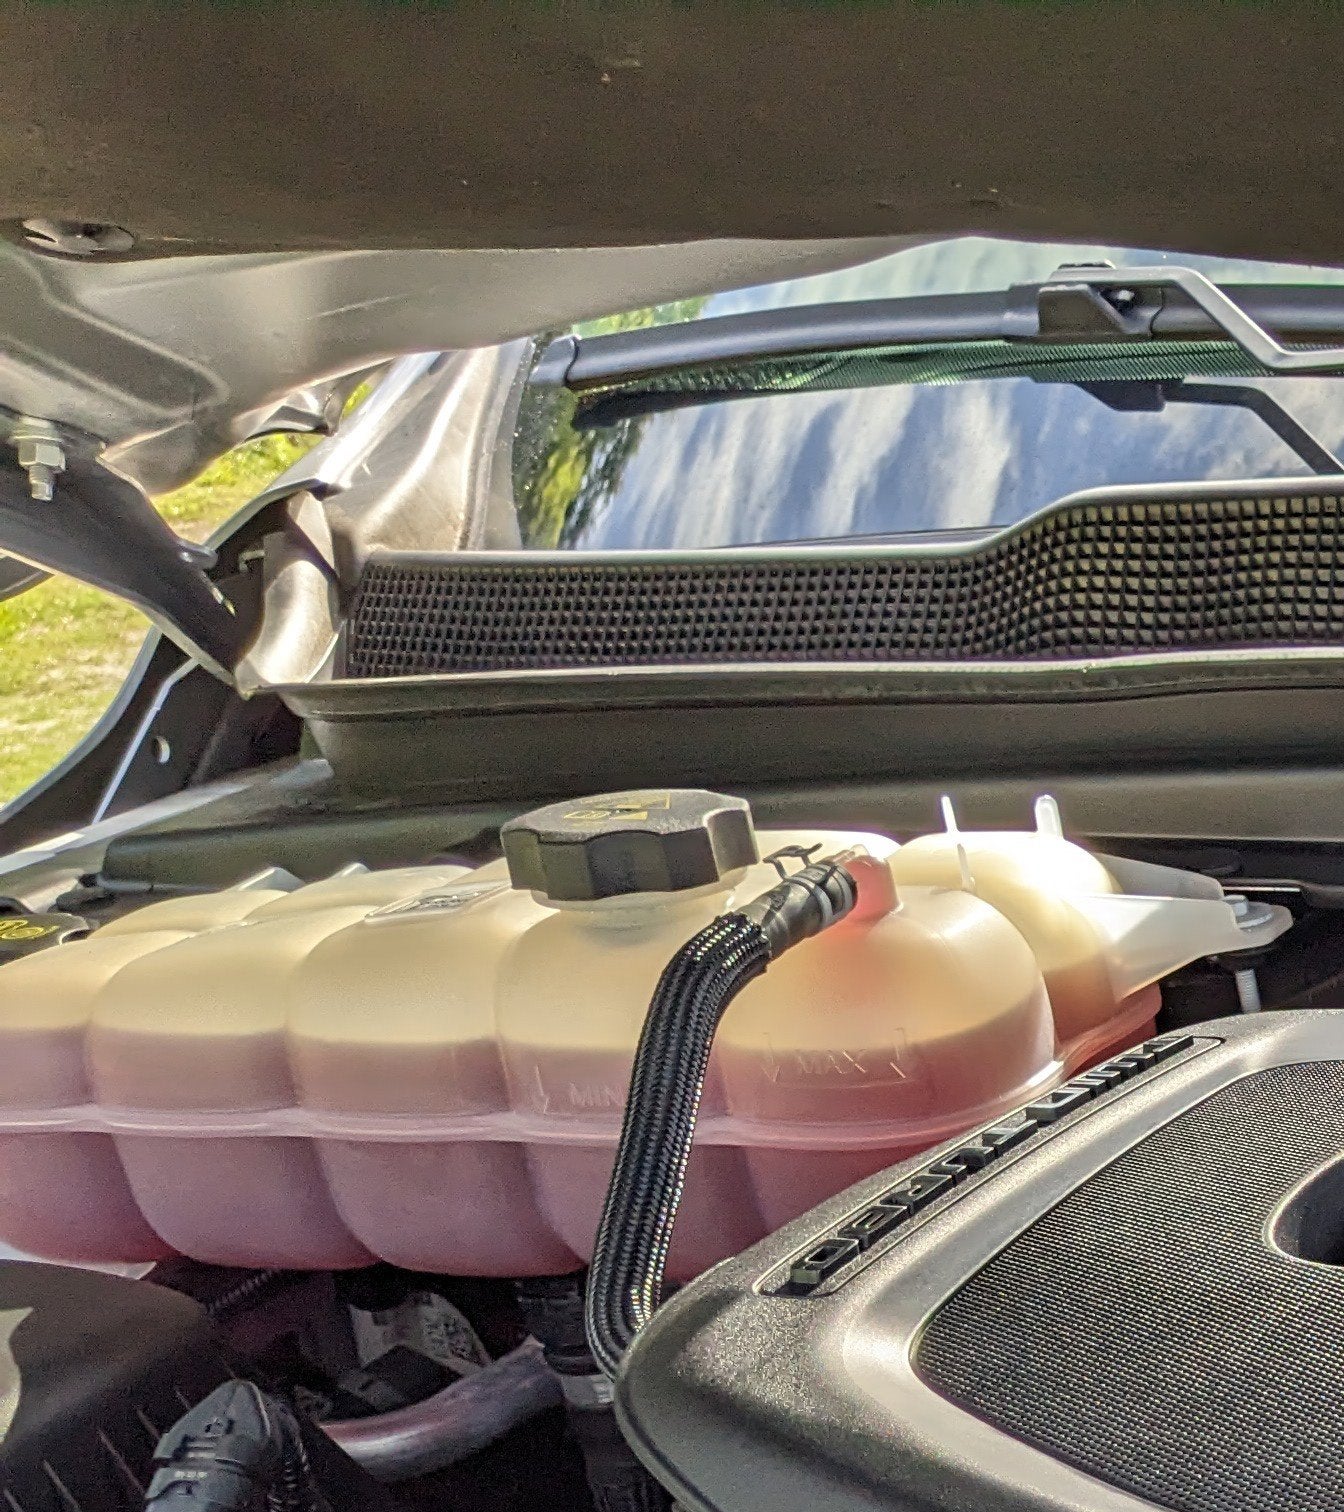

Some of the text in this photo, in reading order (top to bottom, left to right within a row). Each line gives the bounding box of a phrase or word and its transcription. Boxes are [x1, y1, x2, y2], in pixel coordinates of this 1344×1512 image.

[797, 1049, 869, 1075] MAX
[569, 1081, 626, 1107] MIN
[790, 1035, 1194, 1284] TWIN TURBO
